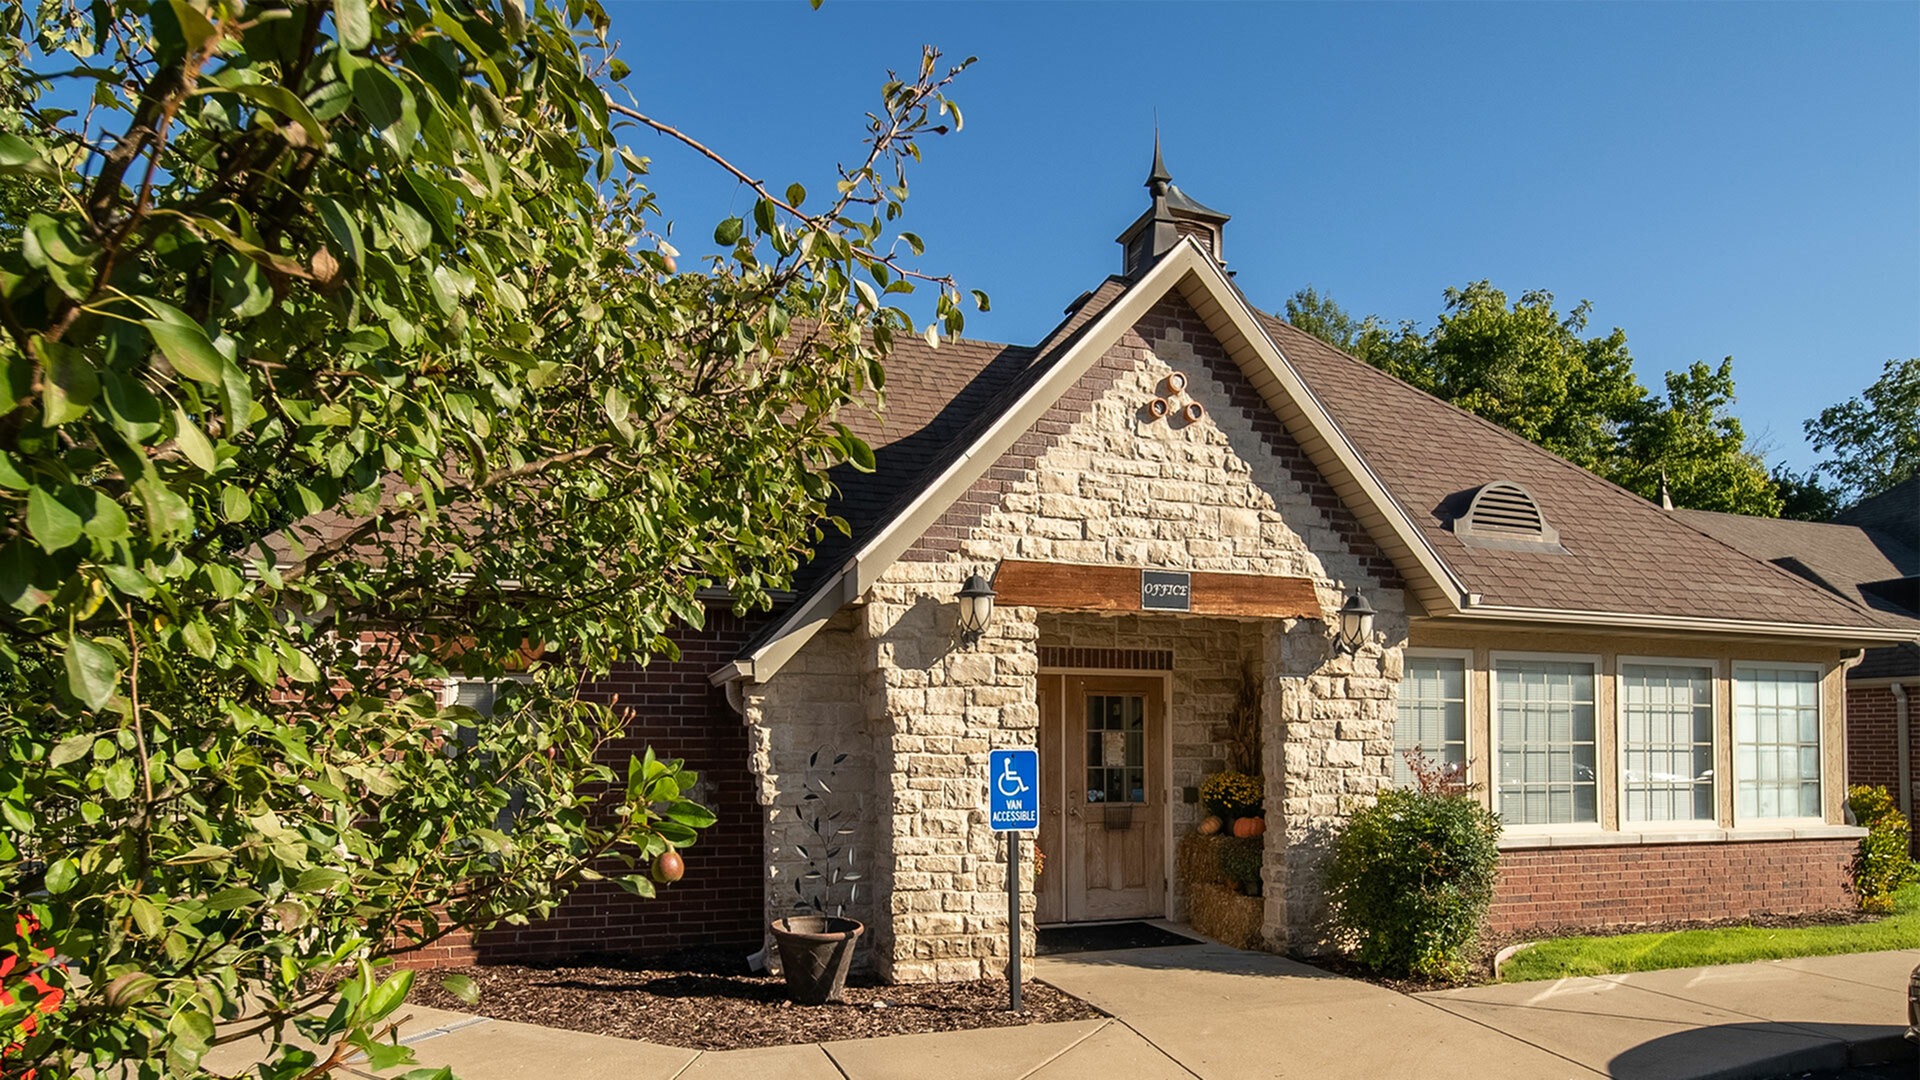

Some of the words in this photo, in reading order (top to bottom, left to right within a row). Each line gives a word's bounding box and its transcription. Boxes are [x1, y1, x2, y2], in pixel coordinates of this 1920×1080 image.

[1144, 583, 1188, 597] OFFICE
[1006, 800, 1022, 809] VAN
[993, 810, 1036, 821] ACCESSIBLE
